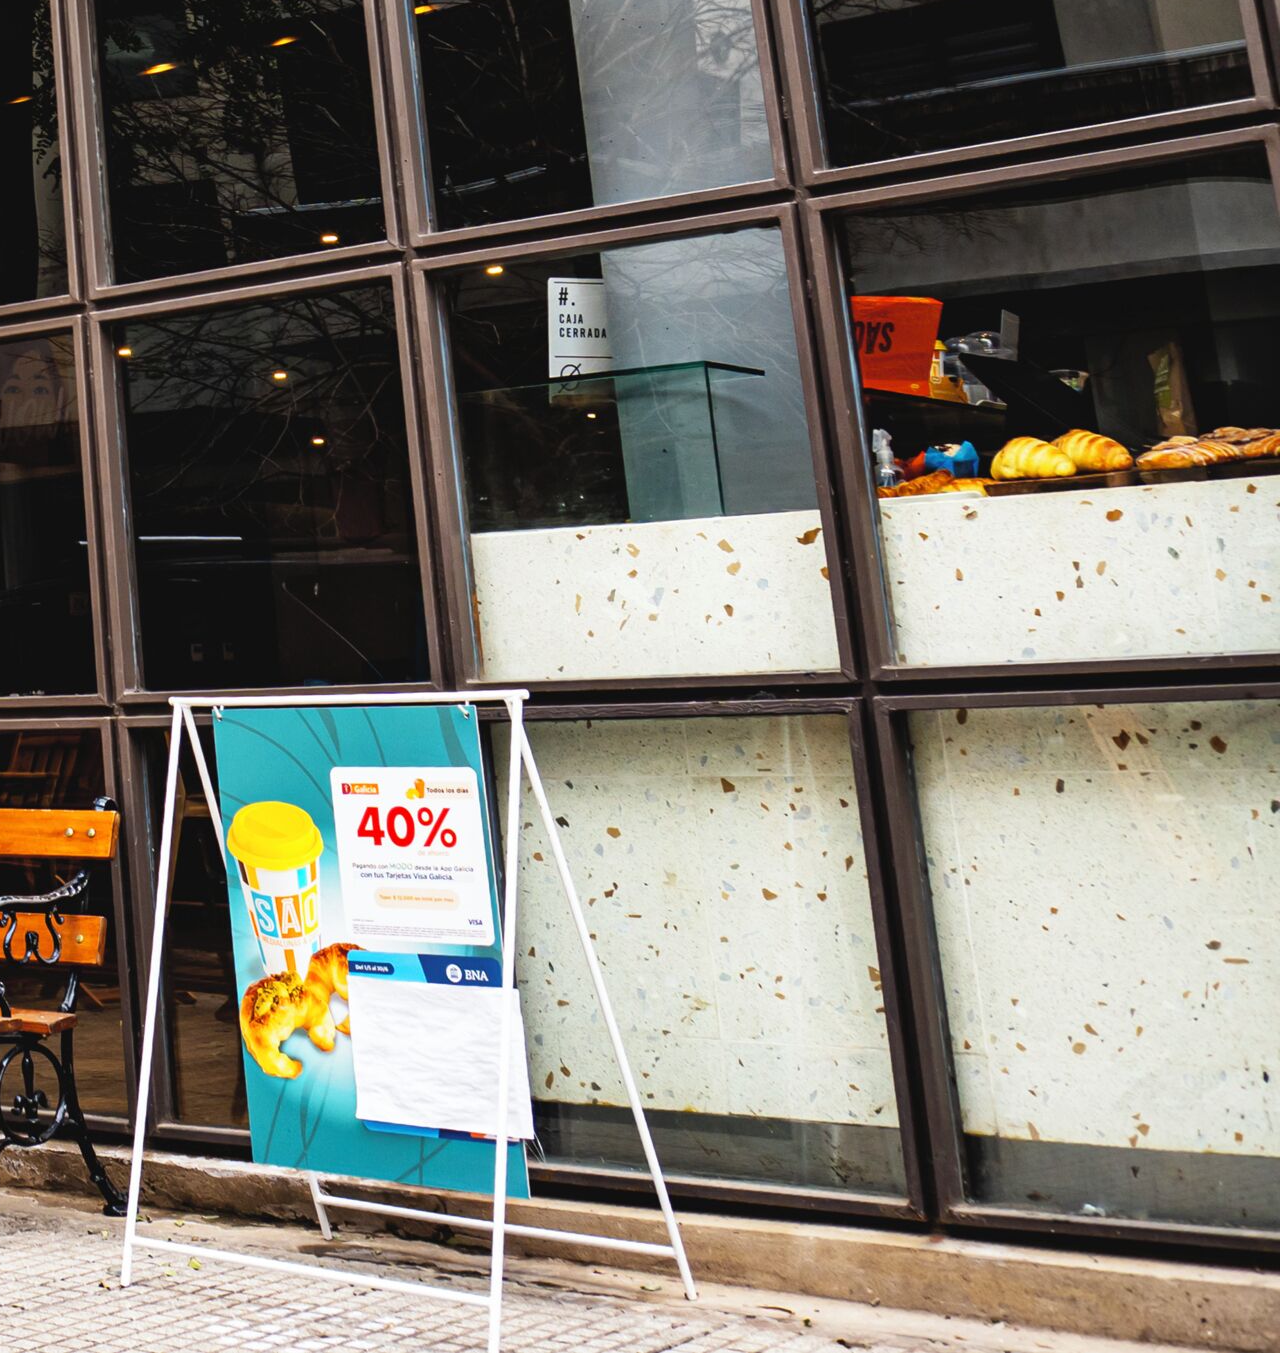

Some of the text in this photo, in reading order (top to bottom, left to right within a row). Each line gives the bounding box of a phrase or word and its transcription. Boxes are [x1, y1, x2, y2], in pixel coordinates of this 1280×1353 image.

[558, 313, 584, 325] CAJA
[558, 327, 608, 339] CERRADA
[353, 784, 378, 795] Galicia
[426, 786, 444, 795] Todos
[445, 786, 455, 794] los
[357, 806, 457, 848] 40%
[373, 871, 384, 879] tus
[386, 872, 412, 881] Tarjetas
[354, 963, 364, 971] Del
[464, 969, 489, 982] BNA
